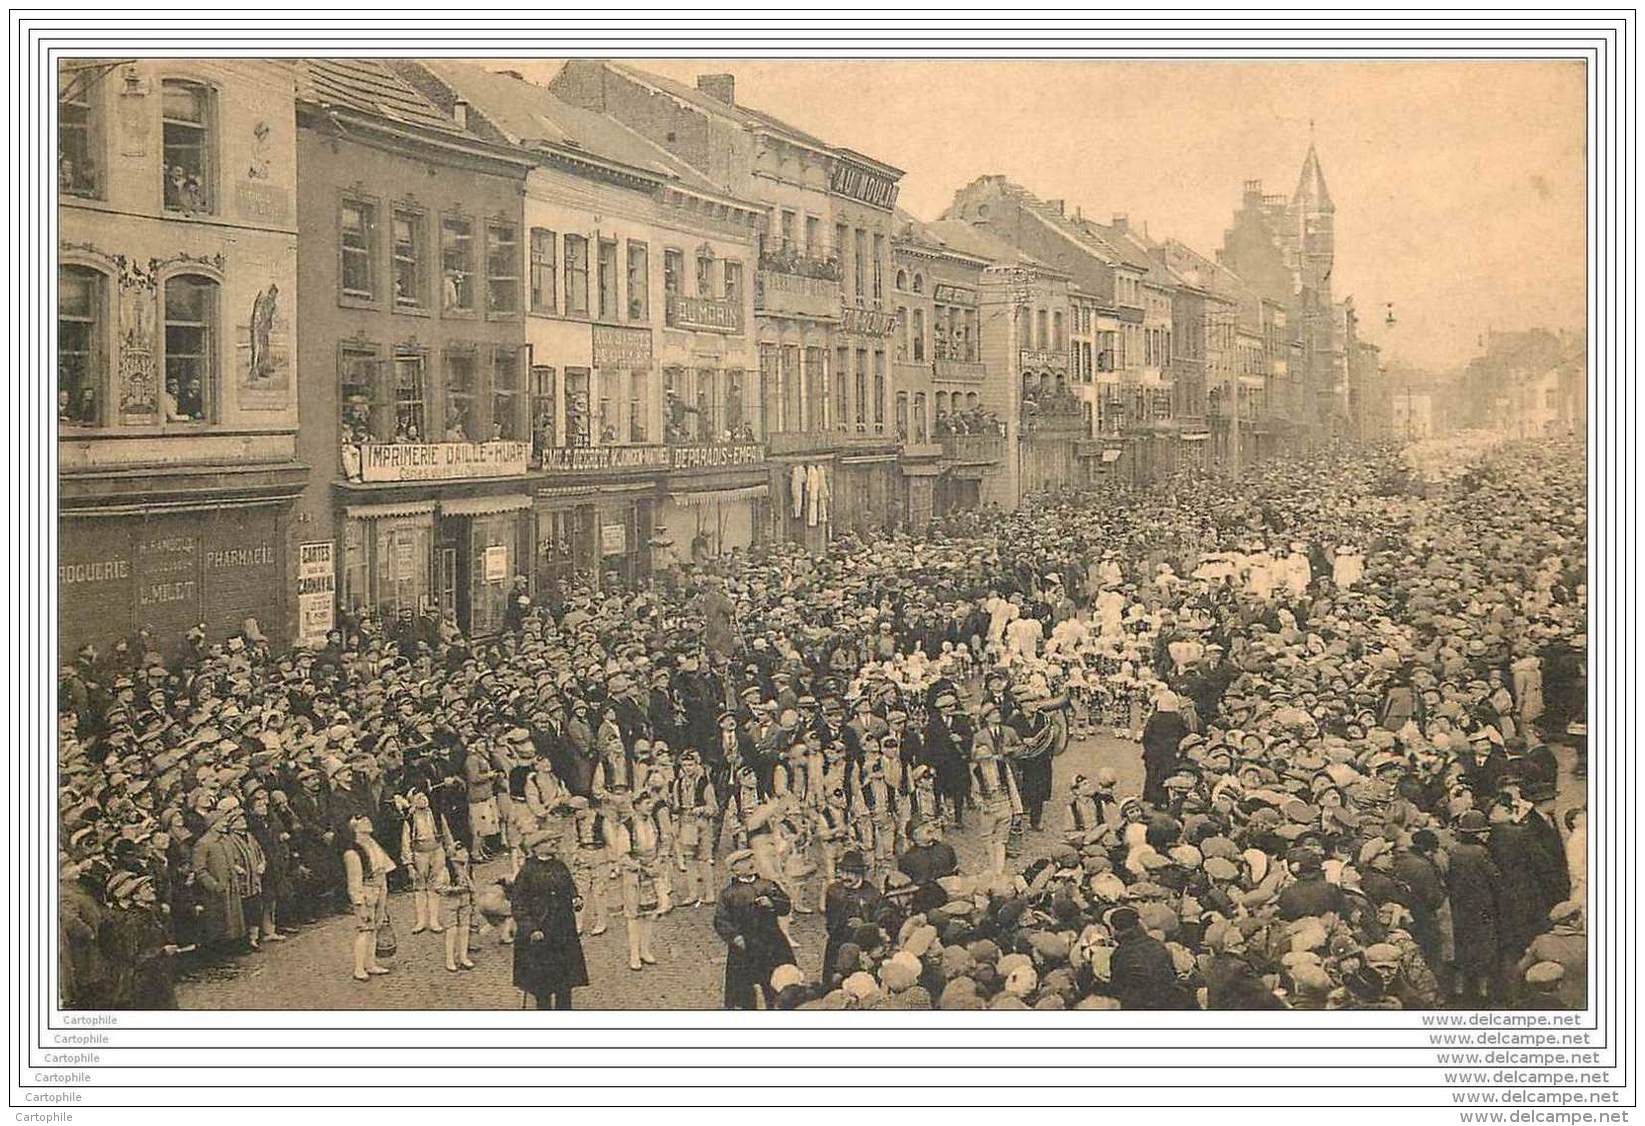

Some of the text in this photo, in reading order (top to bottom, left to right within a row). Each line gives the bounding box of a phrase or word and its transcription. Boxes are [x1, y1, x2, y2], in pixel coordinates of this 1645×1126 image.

[837, 168, 855, 193] AU
[368, 447, 440, 467] IMPRIMERIE
[206, 542, 275, 569] PHARMACIE
